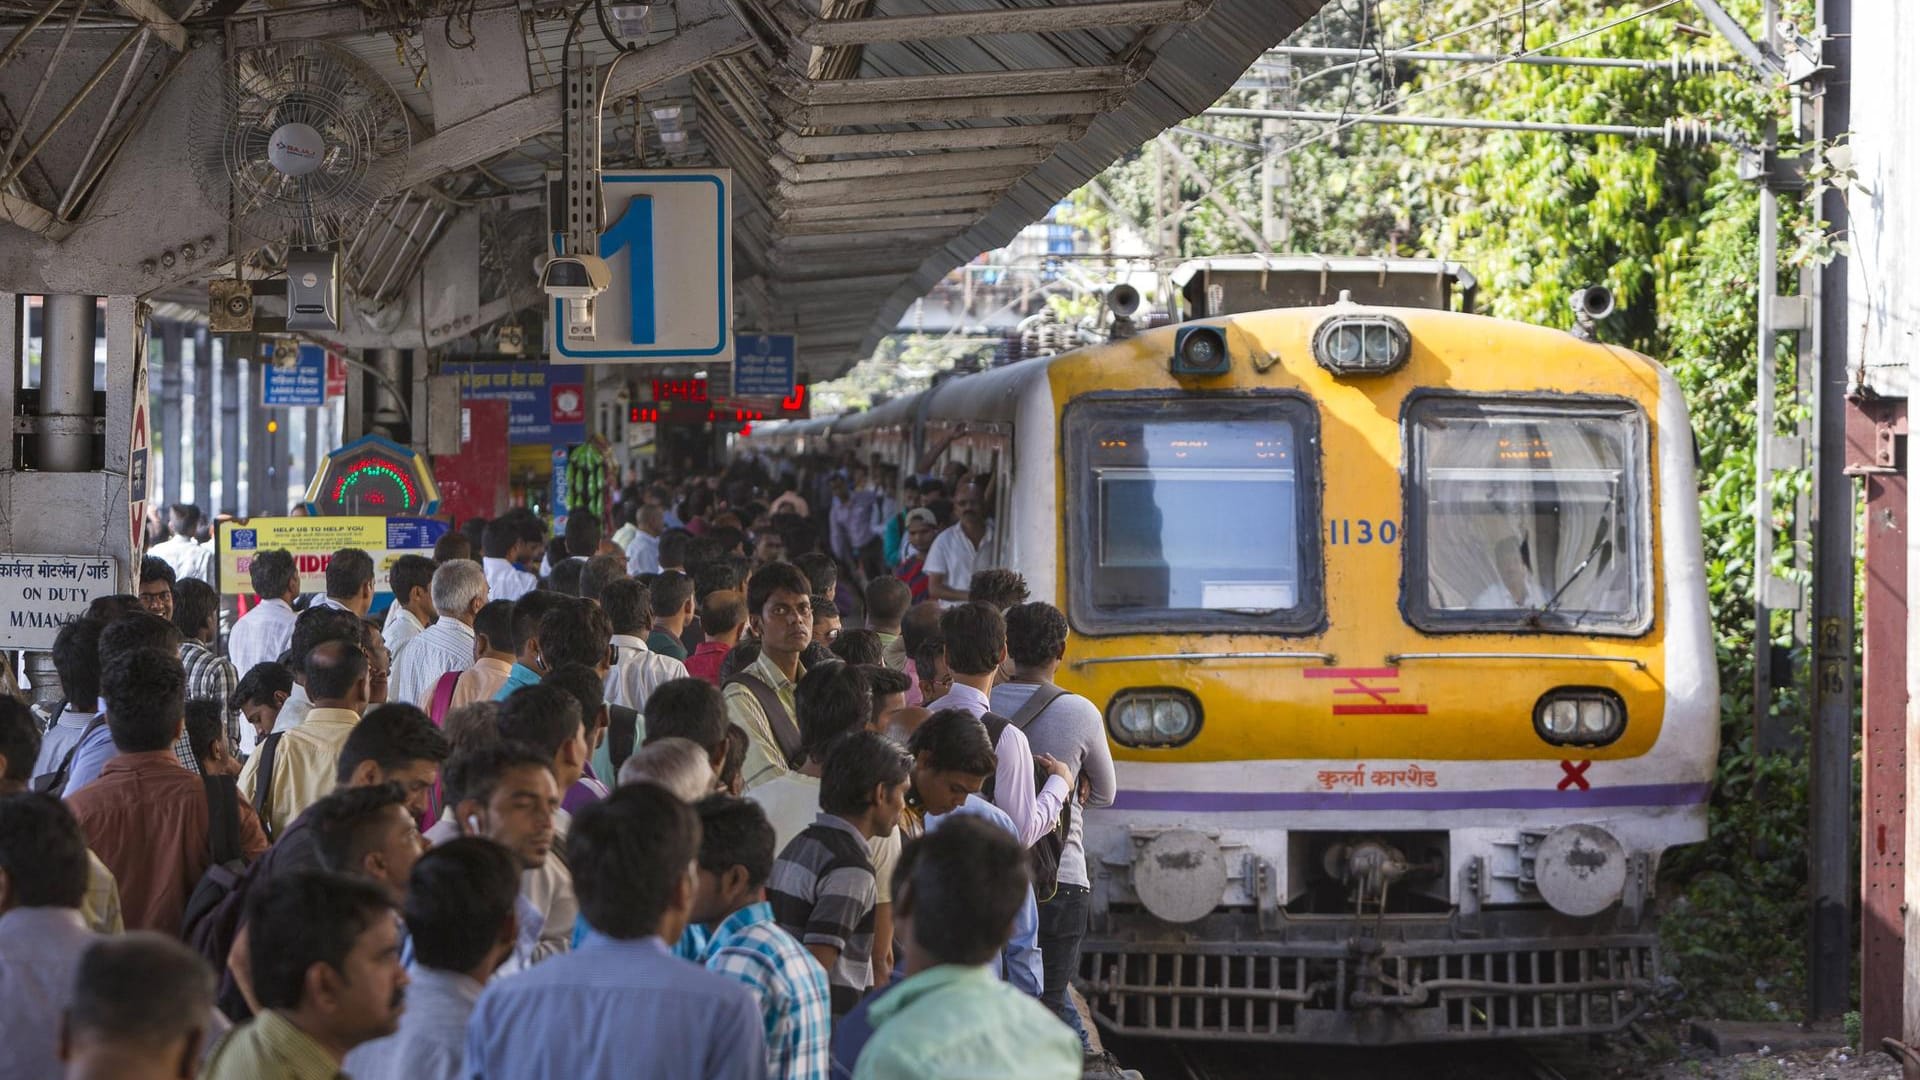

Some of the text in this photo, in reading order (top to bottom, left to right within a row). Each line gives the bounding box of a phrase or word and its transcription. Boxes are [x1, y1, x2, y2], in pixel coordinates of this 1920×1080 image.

[600, 194, 655, 345] 1
[1331, 519, 1397, 545] 1130
[22, 587, 89, 602] ON DUTY
